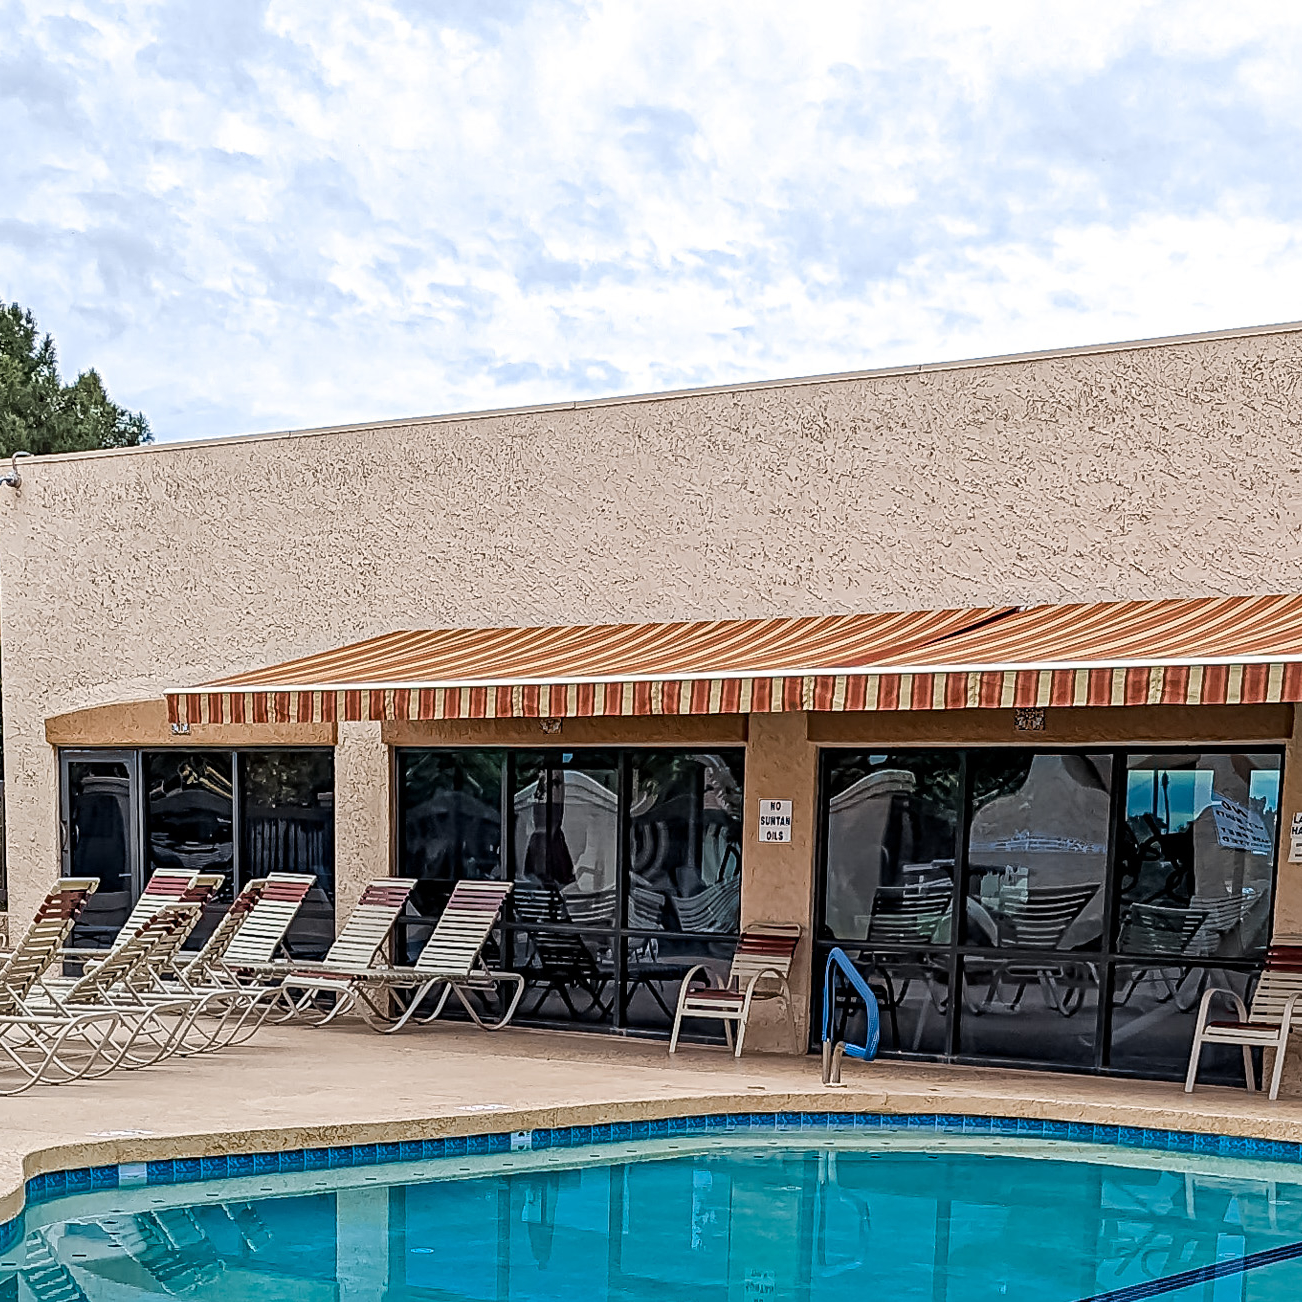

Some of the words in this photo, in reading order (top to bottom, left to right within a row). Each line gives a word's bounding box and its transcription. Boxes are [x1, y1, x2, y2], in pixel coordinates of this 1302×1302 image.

[770, 801, 782, 811] NO
[760, 815, 791, 826] SUNTAN
[766, 830, 784, 841] OILS
